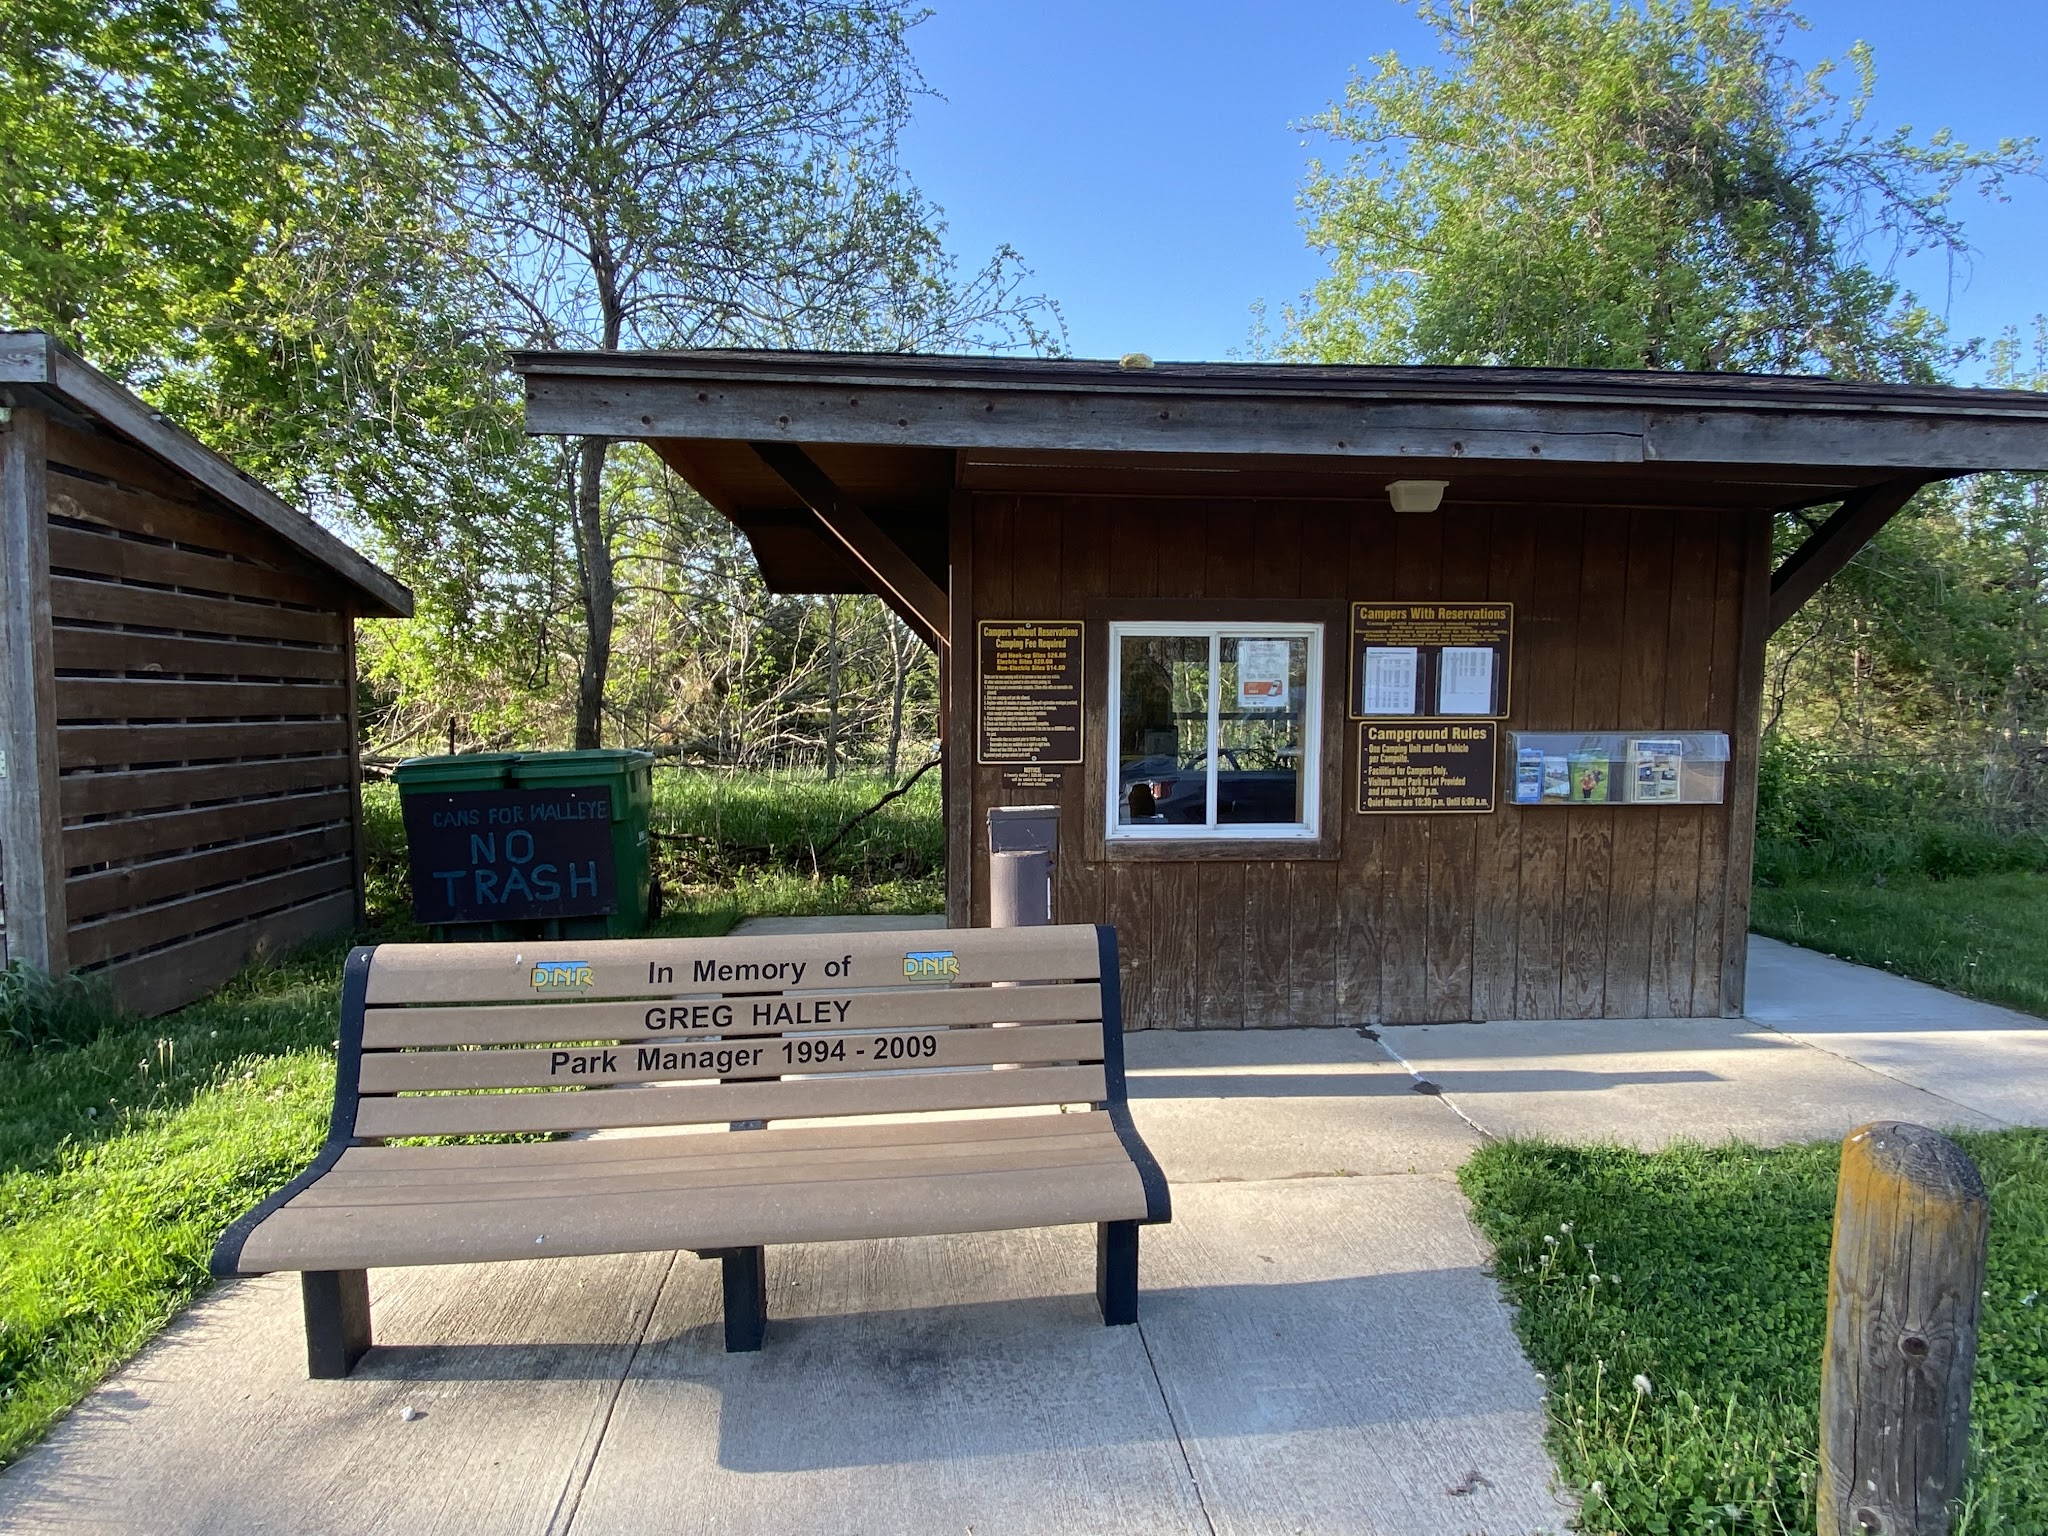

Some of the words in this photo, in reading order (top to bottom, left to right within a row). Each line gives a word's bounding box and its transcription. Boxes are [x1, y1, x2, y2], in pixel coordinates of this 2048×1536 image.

[1360, 607, 1407, 621] Campers
[1411, 608, 1435, 619] With
[1438, 608, 1506, 619] Reservations
[984, 627, 1011, 638] Campers
[1013, 627, 1036, 636] without
[1038, 627, 1078, 636] Reservations
[996, 639, 1023, 650] Camping
[1025, 639, 1037, 648] Fee
[1038, 639, 1066, 649] Required
[1369, 727, 1448, 742] Campground
[1453, 727, 1486, 739] Rules
[1369, 744, 1380, 753] One
[1382, 744, 1407, 754] Camping
[1409, 744, 1421, 753] Unit
[1422, 744, 1433, 752] and
[1435, 744, 1446, 752] One
[1447, 744, 1469, 753] Vehicle
[1369, 756, 1379, 764] per
[1380, 754, 1409, 764] Campsite.
[1368, 766, 1395, 775] Facilities
[1397, 766, 1405, 775] for
[1407, 766, 1432, 776] Campers
[1433, 766, 1448, 776] Only.
[1368, 777, 1390, 786] Visitors
[1392, 777, 1406, 786] Must
[1408, 777, 1422, 786] Park
[1423, 777, 1429, 786] in
[1430, 777, 1439, 786] Lot
[1441, 777, 1466, 786] Provided
[1368, 787, 1379, 795] and
[1381, 787, 1398, 795] Leave
[1400, 787, 1407, 797] by
[1368, 798, 1384, 807] Quiet
[1385, 798, 1402, 806] Hours
[1433, 799, 1445, 808] p.m.
[1446, 797, 1460, 806] Until
[433, 808, 480, 828] CANS
[489, 806, 524, 825] FOR
[530, 800, 608, 821] WALLEYE
[471, 829, 534, 865] NO
[433, 860, 597, 907] TRASH
[648, 962, 673, 984] In
[693, 959, 807, 986] Memory
[824, 955, 852, 978] of
[903, 956, 960, 976] DNR
[530, 967, 594, 987] DNR
[645, 1005, 733, 1031] GREG
[753, 1000, 852, 1026] HALEY
[550, 1050, 618, 1075] Park
[637, 1045, 764, 1073] Manager
[781, 1039, 845, 1065] 1994
[873, 1035, 938, 1060] 2009
